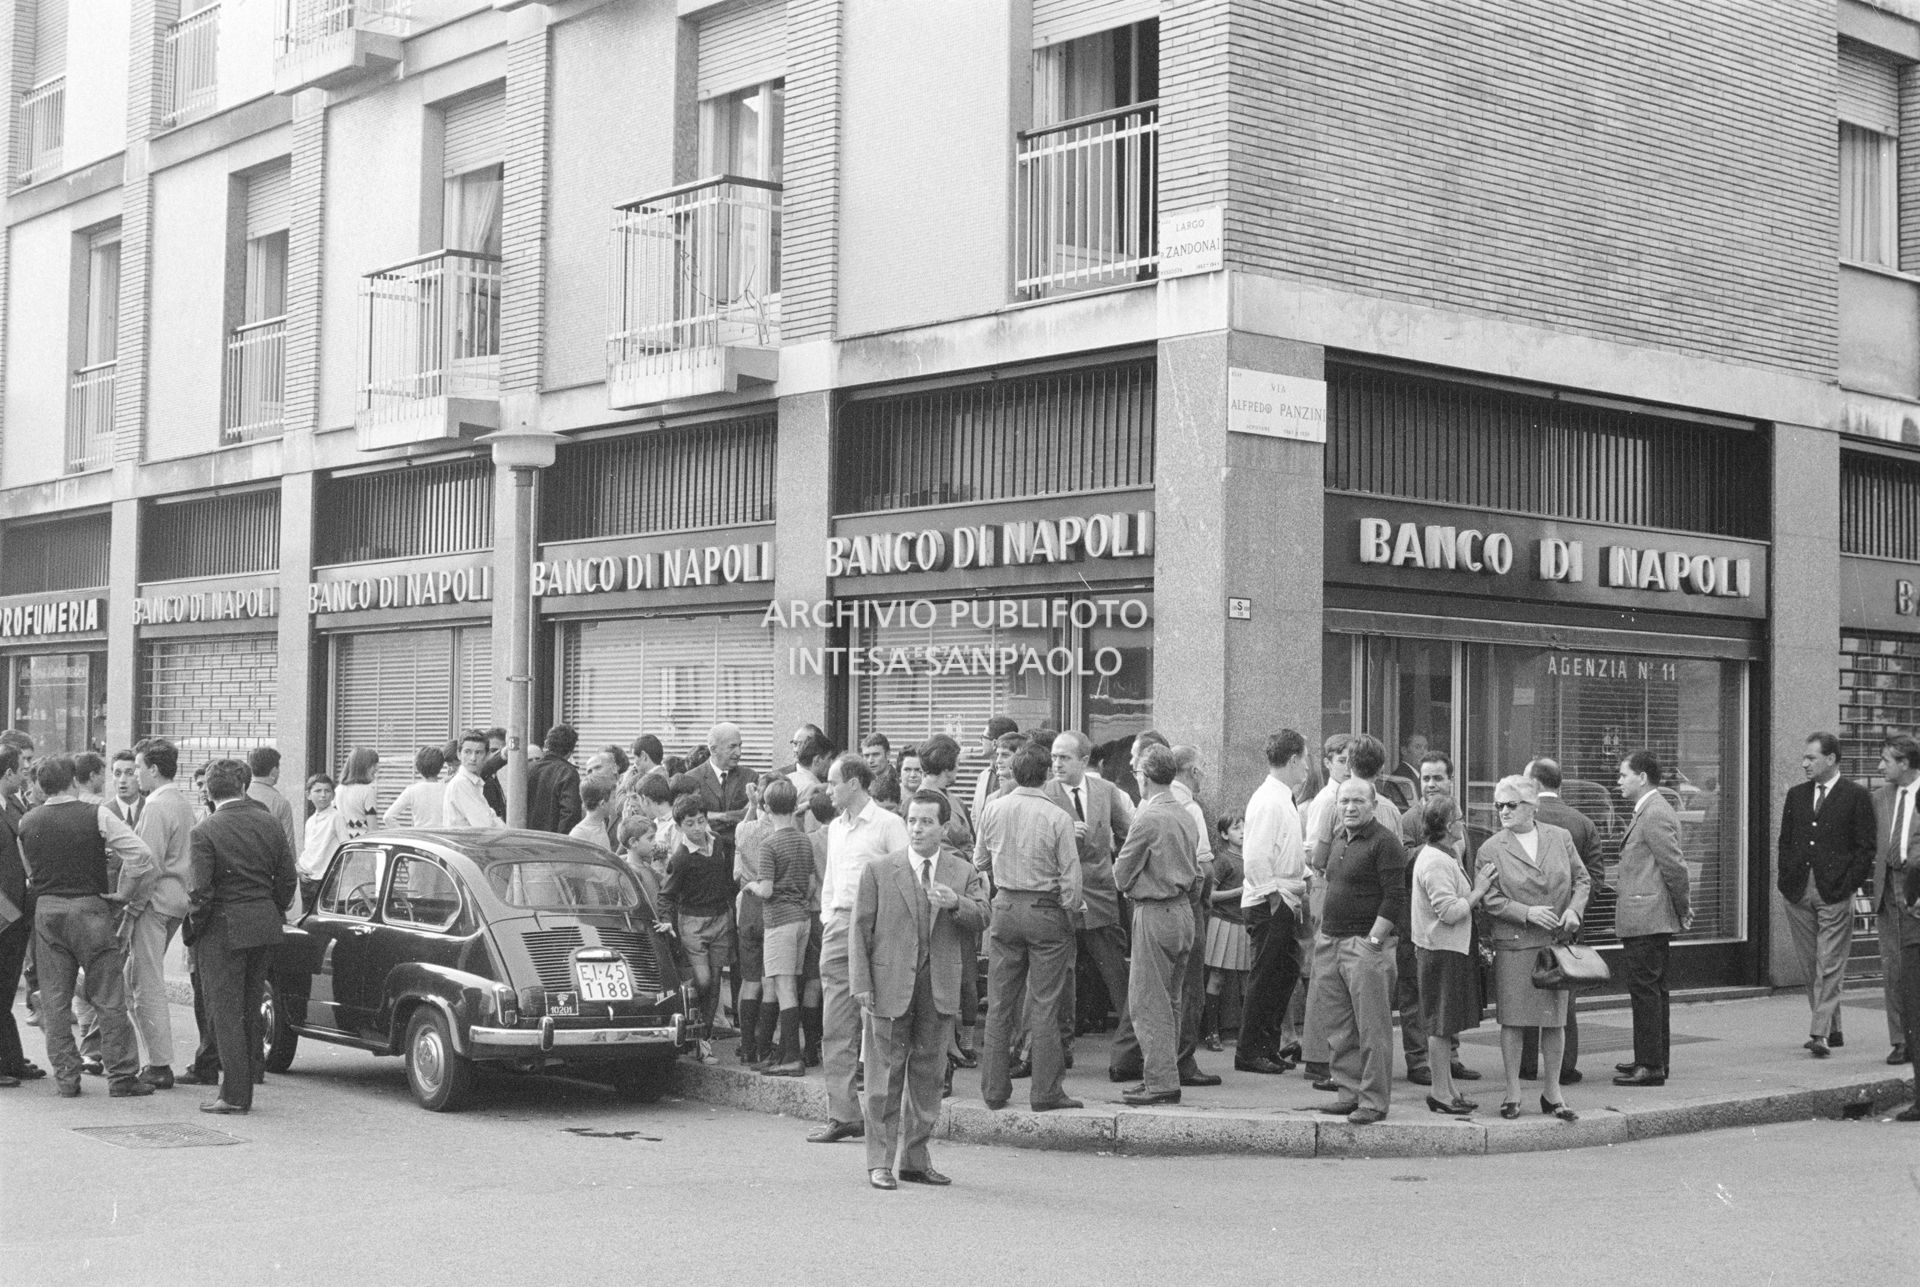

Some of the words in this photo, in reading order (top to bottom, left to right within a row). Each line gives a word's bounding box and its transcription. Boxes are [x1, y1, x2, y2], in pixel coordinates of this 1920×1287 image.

[1175, 219, 1205, 233] LARGO
[1166, 237, 1220, 259] ZANDONAI
[1271, 383, 1286, 393] VIA
[1231, 399, 1272, 414] ALFREDO
[1280, 403, 1326, 423] PANZINI
[826, 529, 937, 577] BANCO
[953, 525, 987, 569] DI
[1002, 510, 1146, 565] NAPOLI
[532, 556, 616, 597] BANCO
[627, 553, 651, 590] DI
[663, 541, 769, 587] NAPOLI
[1360, 517, 1514, 575] BANCO
[1539, 537, 1584, 583] DI
[1609, 545, 1751, 598] NAPOLI
[308, 579, 371, 614] BANCO
[379, 575, 398, 608] DI
[406, 566, 488, 606] NAPOLI
[132, 595, 184, 625] BANCO
[190, 593, 205, 622] DI
[212, 588, 274, 620] NAPOLI
[1548, 656, 1627, 679] AGENZIA
[1662, 663, 1676, 681] 11
[585, 982, 629, 998] 1188
[550, 1006, 573, 1014] 10201
